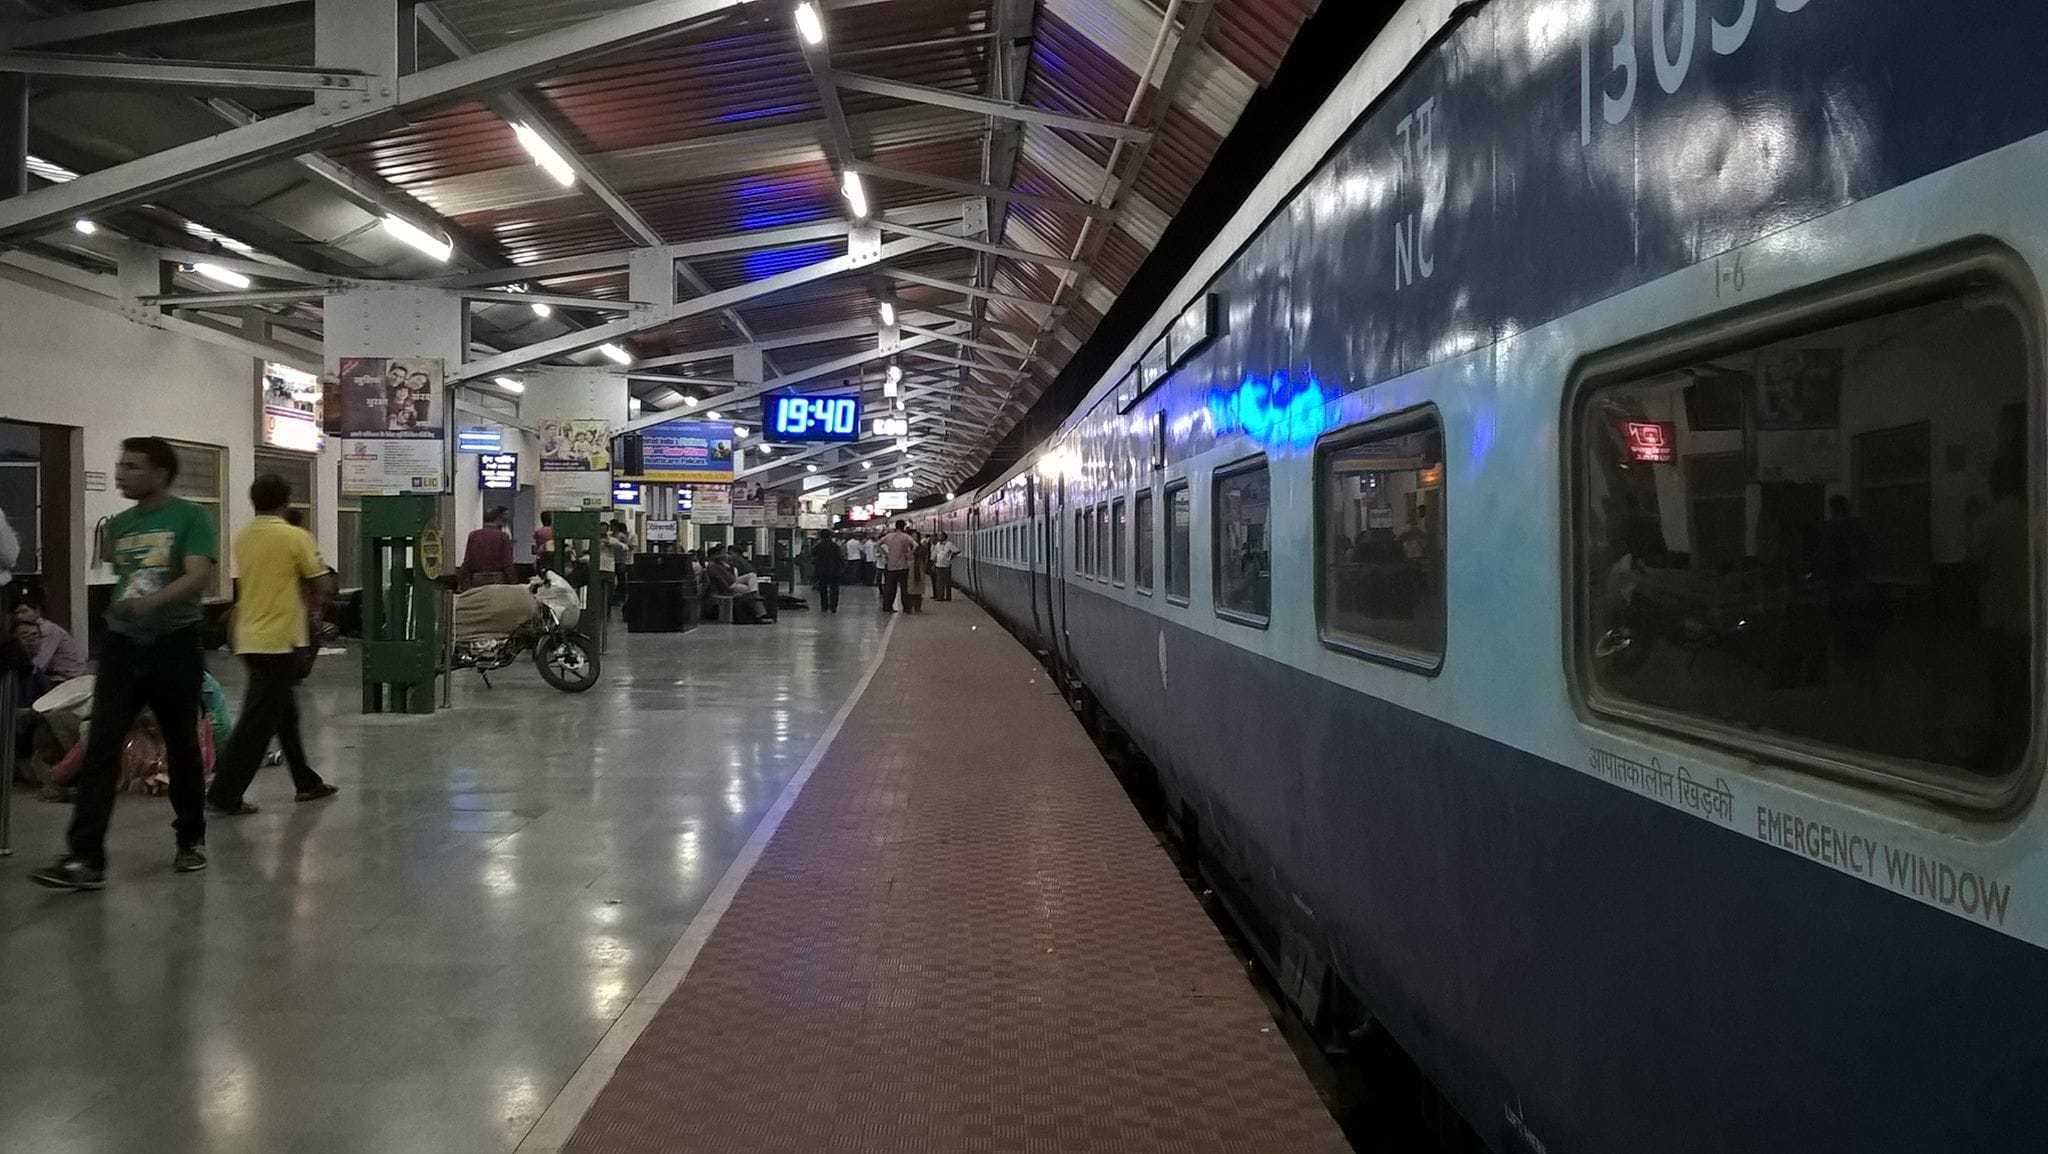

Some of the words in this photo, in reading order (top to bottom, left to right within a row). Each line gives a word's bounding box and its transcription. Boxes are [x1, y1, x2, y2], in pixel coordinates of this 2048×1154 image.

[1395, 207, 1434, 291] NC
[777, 398, 855, 434] 19:40
[1590, 746, 1674, 798] आपातकालीन
[1677, 767, 1734, 823] खिड़की
[1757, 806, 1877, 877] EMERGENCY
[1883, 845, 2011, 926] WINDOW
